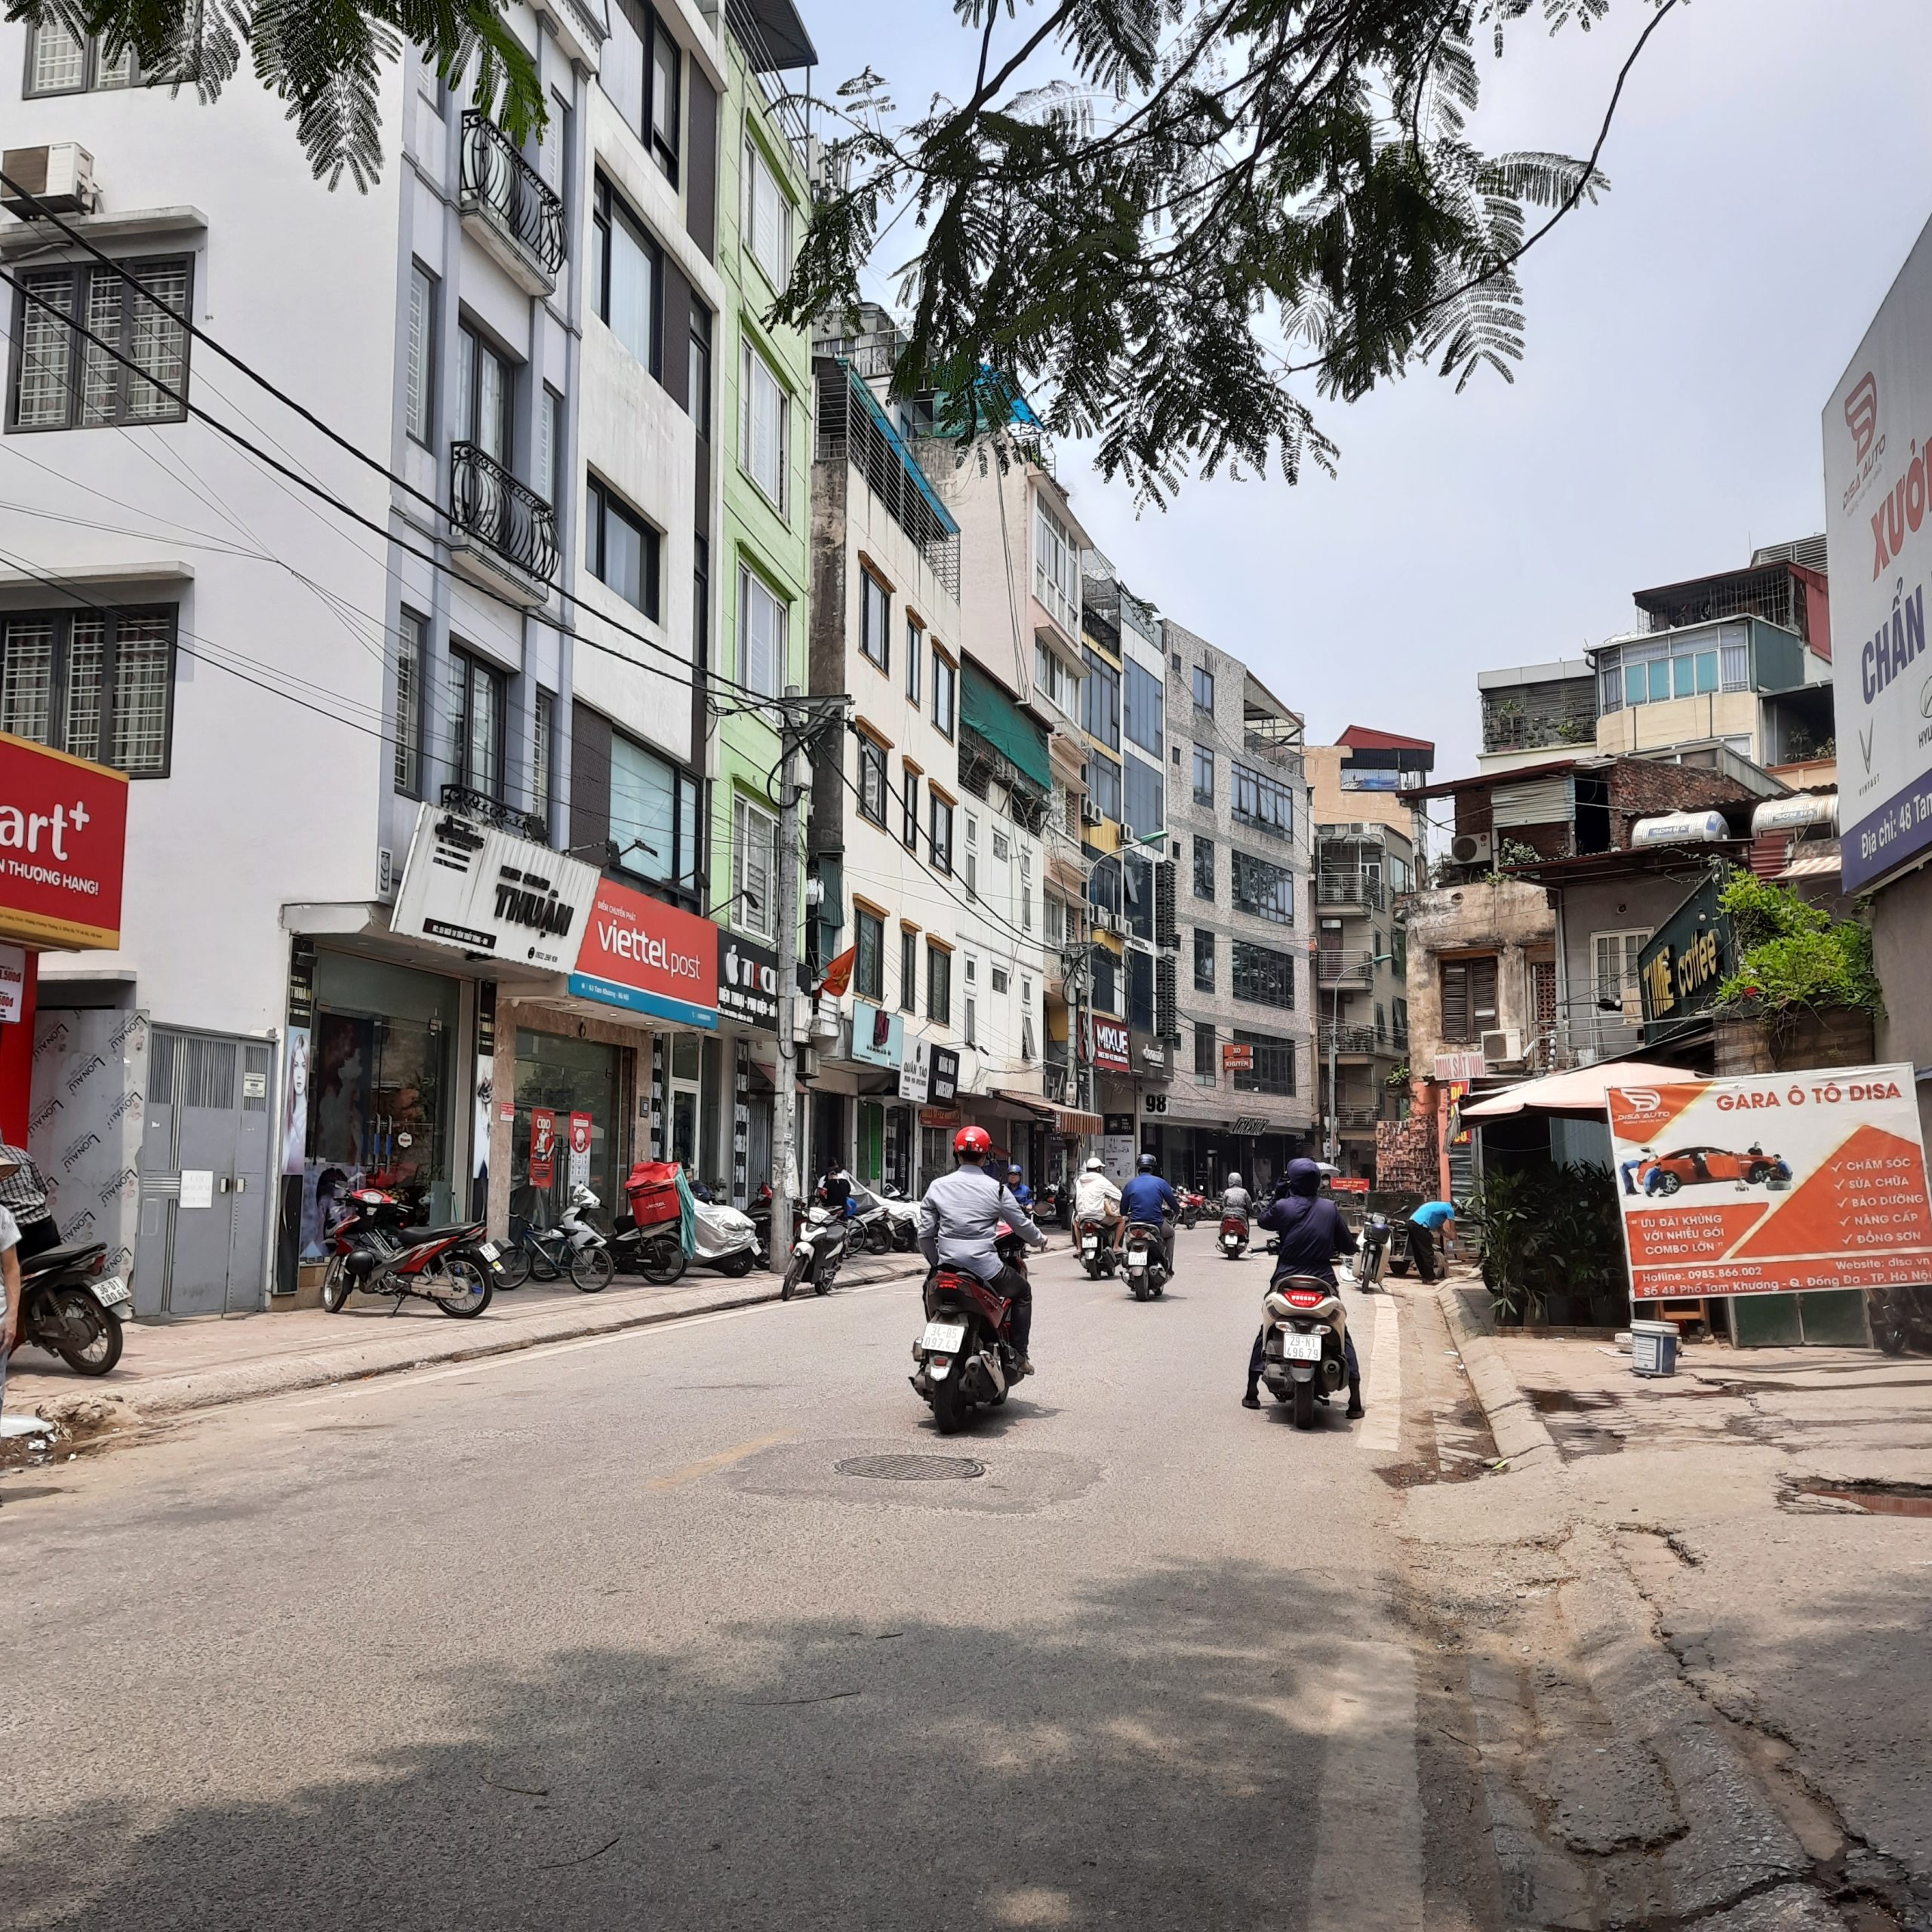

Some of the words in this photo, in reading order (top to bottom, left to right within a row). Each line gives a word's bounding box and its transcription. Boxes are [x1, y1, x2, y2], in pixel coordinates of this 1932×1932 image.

[1863, 434, 1886, 481] AUTO
[1862, 576, 1925, 705] CHẨN
[1862, 829, 1877, 860] Địa
[1879, 809, 1897, 848] chỉ:
[1900, 803, 1912, 832] 48
[63, 874, 99, 895] HẠNG!
[494, 884, 574, 938] THUẬN
[598, 919, 669, 970] viettel
[671, 952, 700, 980] post
[1643, 946, 1675, 1020] TIME
[1678, 928, 1717, 998] coffee
[110, 1015, 148, 1050] LIONALU
[1097, 1023, 1128, 1054] MIXUE
[69, 1057, 106, 1092] LIONALU
[1435, 1058, 1452, 1079] MUA
[1146, 1094, 1166, 1112] 98
[1717, 1091, 1780, 1111] GARA
[1787, 1085, 1805, 1106] Ô
[1811, 1082, 1841, 1103] TÔ
[1848, 1082, 1902, 1101] DISA
[64, 1134, 100, 1169] LIONALU
[1847, 1159, 1882, 1171] CHĂM
[1887, 1156, 1911, 1168] SÓC
[101, 1169, 138, 1204] LIONALU
[1849, 1177, 1871, 1189] SỬA
[1852, 1195, 1877, 1207] BẢO
[1880, 1193, 1924, 1205] DƯỠNG
[1641, 1219, 1655, 1228] ƯU
[1660, 1216, 1678, 1226] ĐÃI
[1682, 1214, 1722, 1226] KHỦNG
[1854, 1214, 1889, 1225] NÂNG
[1893, 1210, 1918, 1222] CẤP
[1644, 1230, 1663, 1241] VỚI
[1703, 1227, 1724, 1238] GÓI
[1897, 1232, 1921, 1241] SƠN
[1645, 1244, 1688, 1255] COMBO
[1693, 1241, 1715, 1253] LỚN
[1835, 1259, 1884, 1270] Website:
[1888, 1257, 1930, 1267] disa.vn
[1643, 1273, 1685, 1282] Hotline:
[1688, 1267, 1762, 1280] 0985.866.002
[1644, 1284, 1658, 1296] Số
[1662, 1285, 1675, 1294] 48
[1680, 1282, 1702, 1294] Phố
[1705, 1283, 1728, 1292] Tam
[1733, 1281, 1779, 1291] Khương
[1807, 1275, 1839, 1287] Đống
[1844, 1275, 1860, 1284] Đa
[1871, 1273, 1886, 1282] TP.
[1890, 1271, 1907, 1281] Hà
[97, 1280, 120, 1294] 36-D1
[924, 1337, 958, 1350] 097.43
[1287, 1346, 1318, 1359] 496.79
